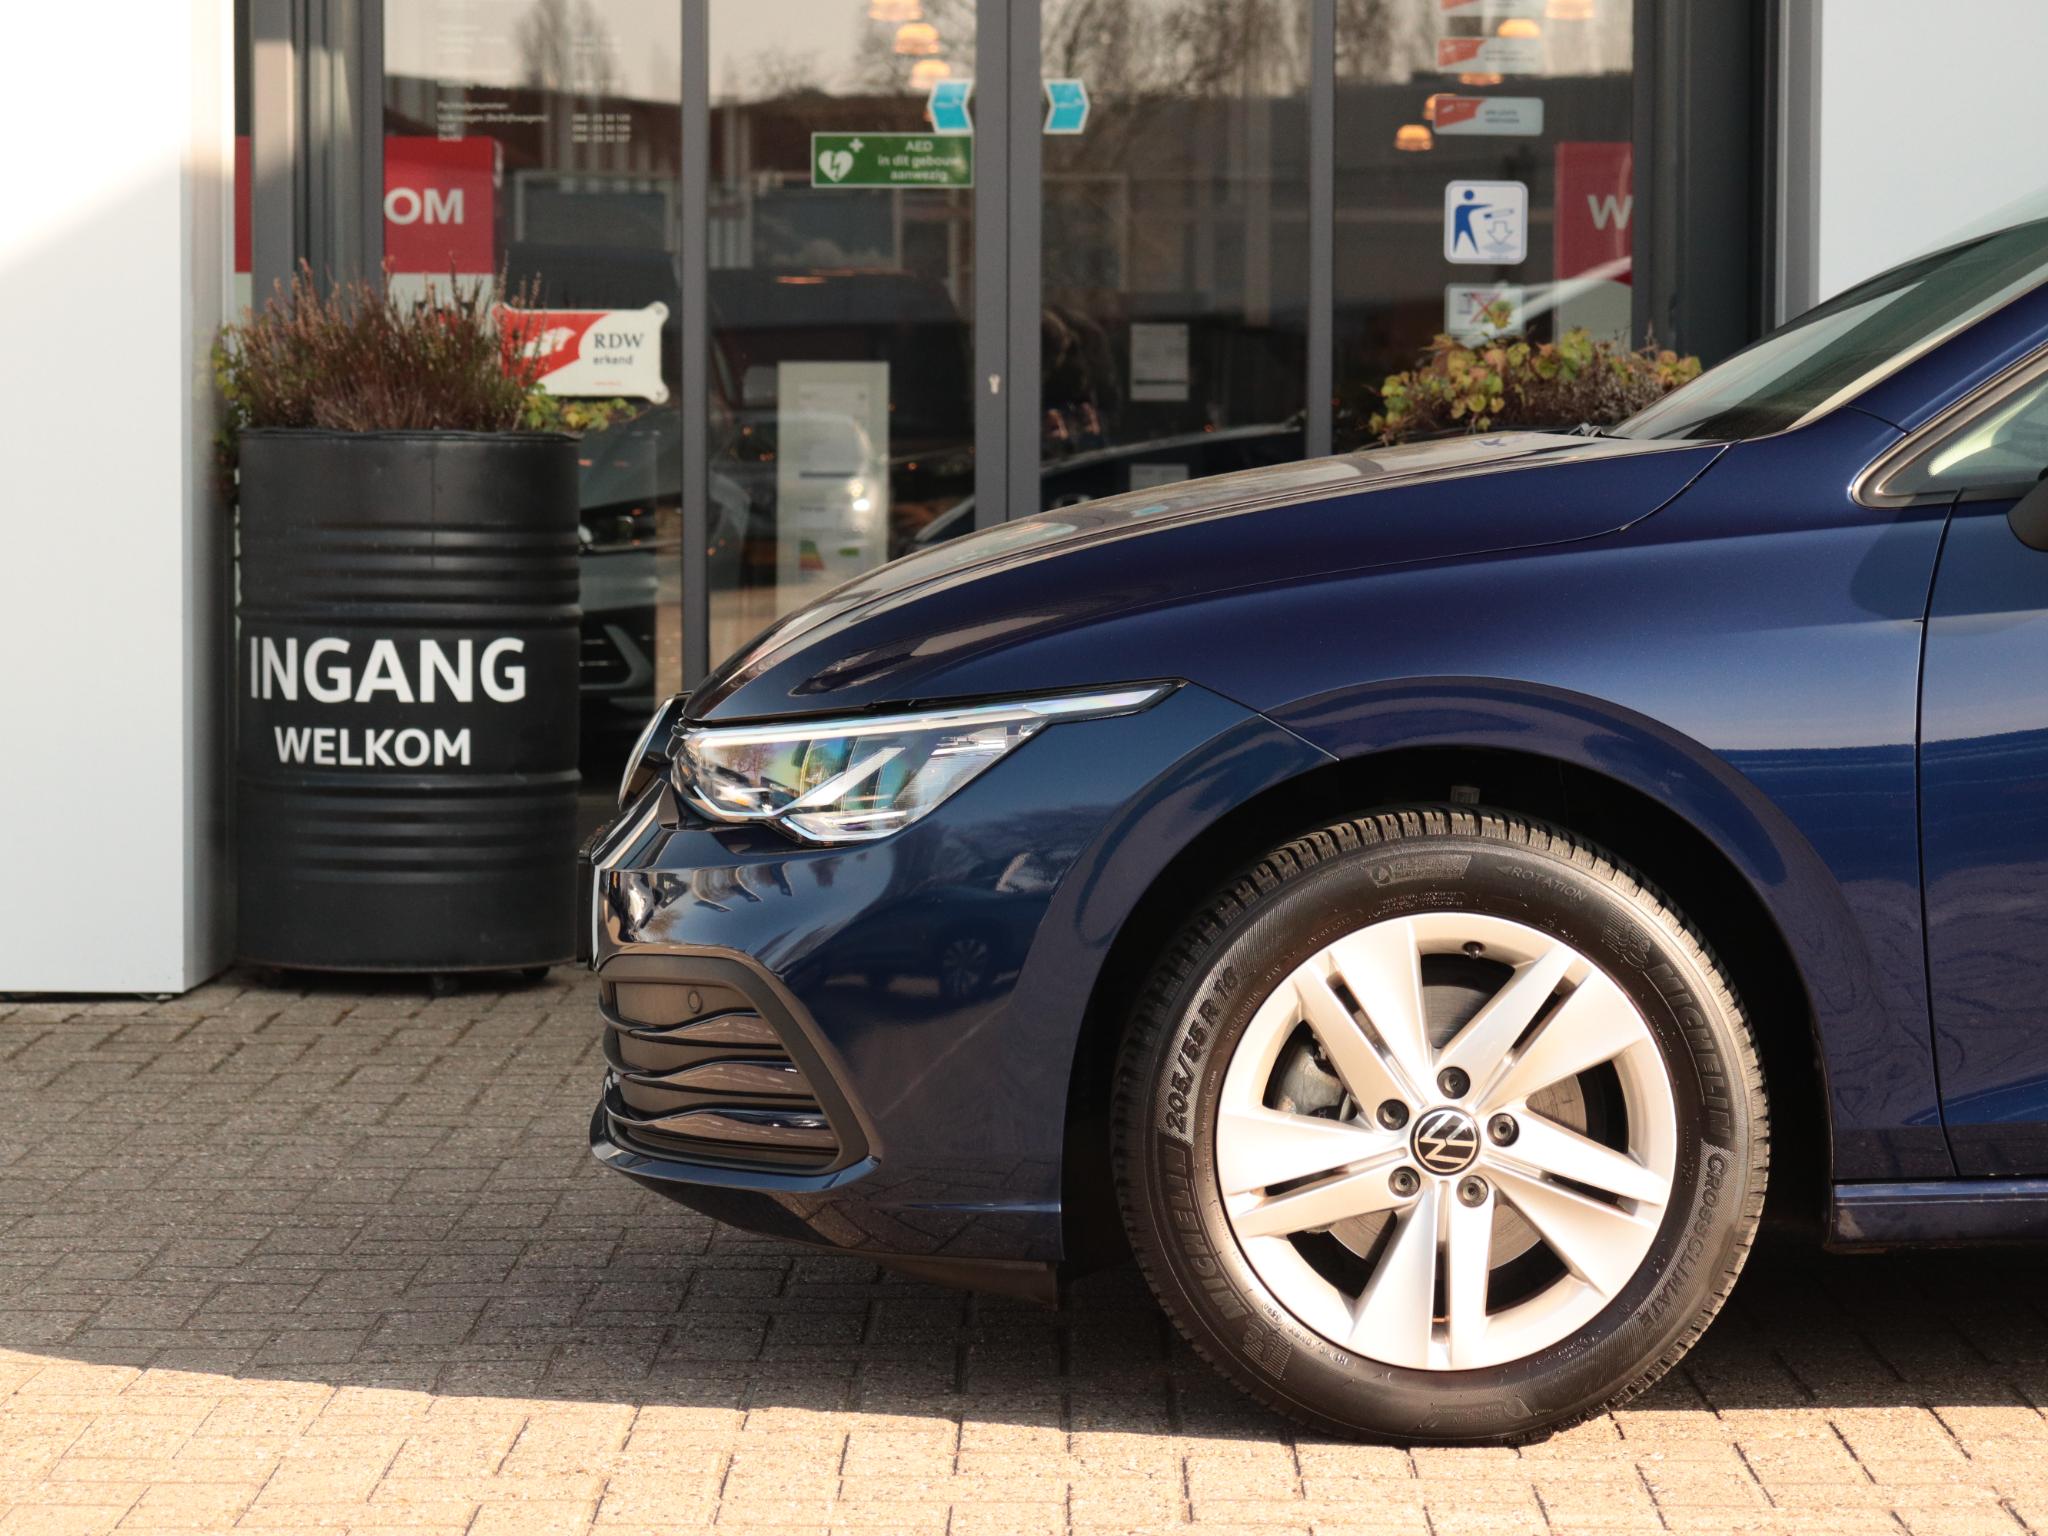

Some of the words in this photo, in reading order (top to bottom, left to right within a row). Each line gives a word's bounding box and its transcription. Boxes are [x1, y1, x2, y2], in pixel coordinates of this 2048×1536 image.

[892, 154, 909, 166] dit
[905, 140, 933, 152] AED
[890, 170, 949, 183] aanwezig
[593, 332, 644, 349] RDW
[592, 354, 634, 366] erkend
[250, 635, 526, 703] INGANG
[273, 726, 471, 766] WELKOM
[1510, 866, 1588, 902] ROTATION
[1164, 1019, 1209, 1135] 205/55
[1198, 999, 1220, 1024] R
[1647, 963, 1731, 1138] MICHELIN
[1165, 1144, 1249, 1320] MICHELIN
[1638, 1152, 1729, 1329] CROSSCLIMATE
